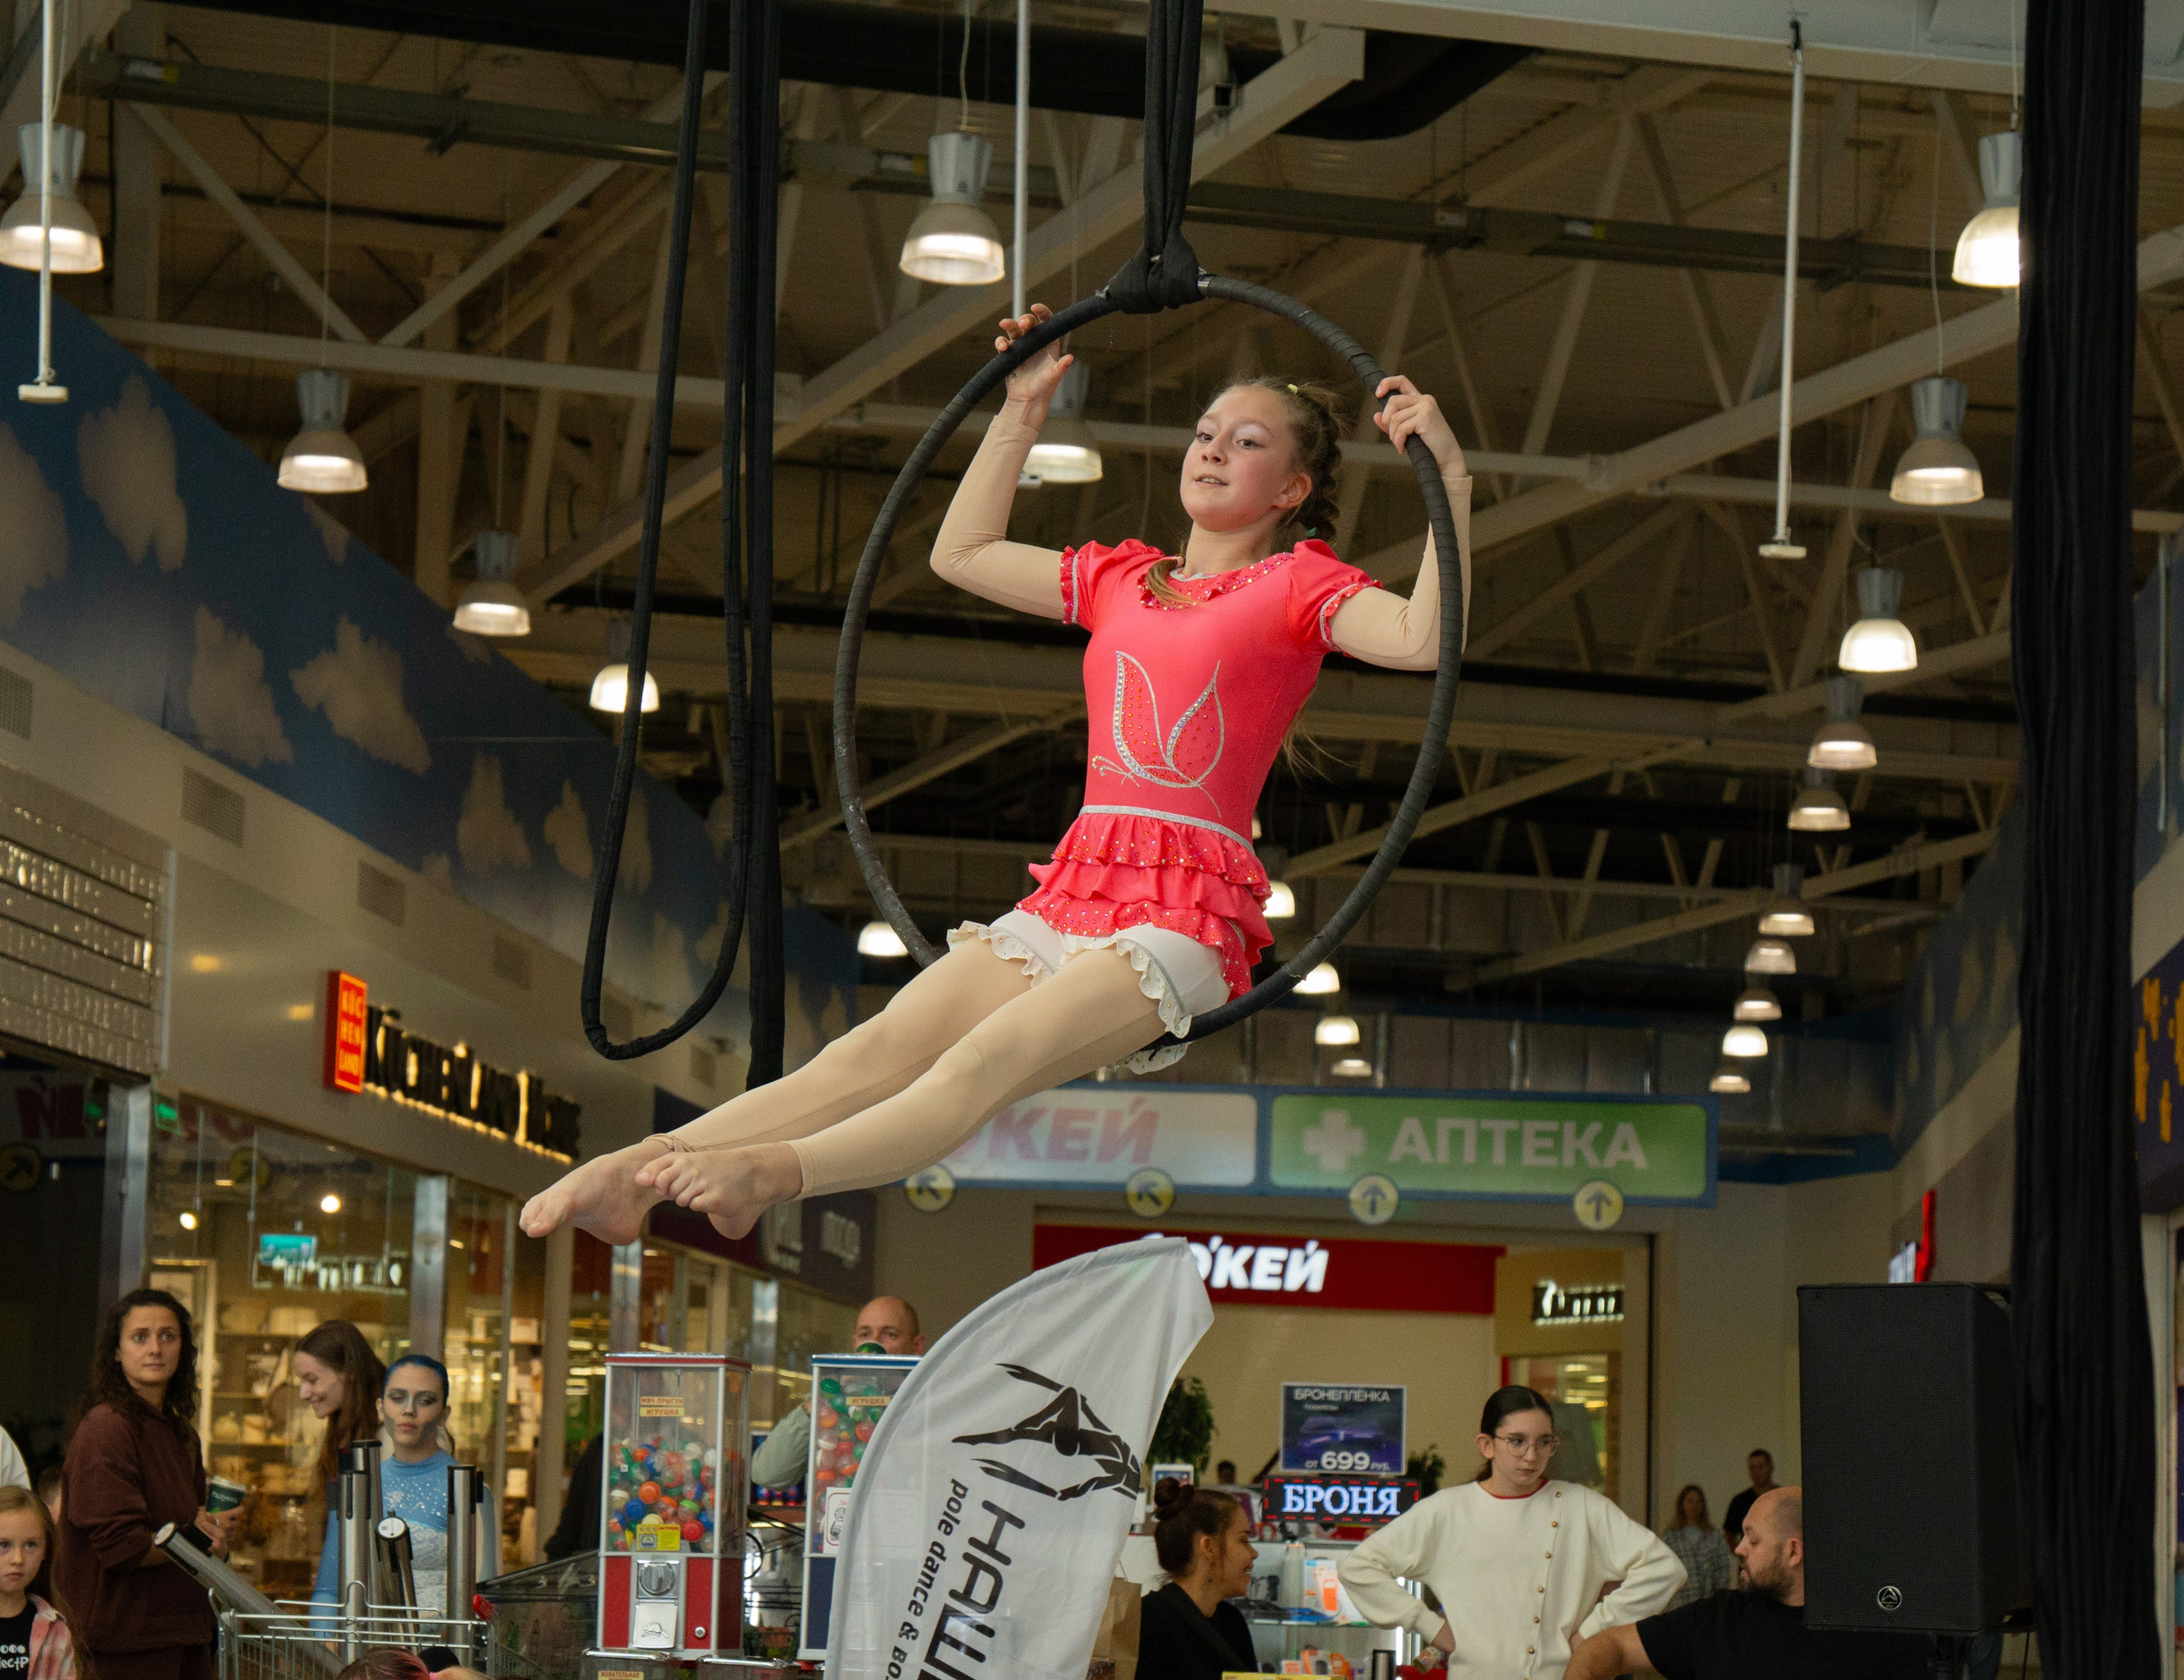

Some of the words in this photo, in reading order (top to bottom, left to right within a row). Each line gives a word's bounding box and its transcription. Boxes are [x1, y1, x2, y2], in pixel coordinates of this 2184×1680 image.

[944, 1096, 1160, 1164] КЕЙ
[1388, 1116, 1647, 1169] АПТЕКА
[1321, 1451, 1371, 1471] 699
[937, 1478, 969, 1537] pole
[1281, 1483, 1401, 1515] БРОНЯ
[908, 1540, 947, 1617] dance
[916, 1499, 1026, 1680] НАШ
